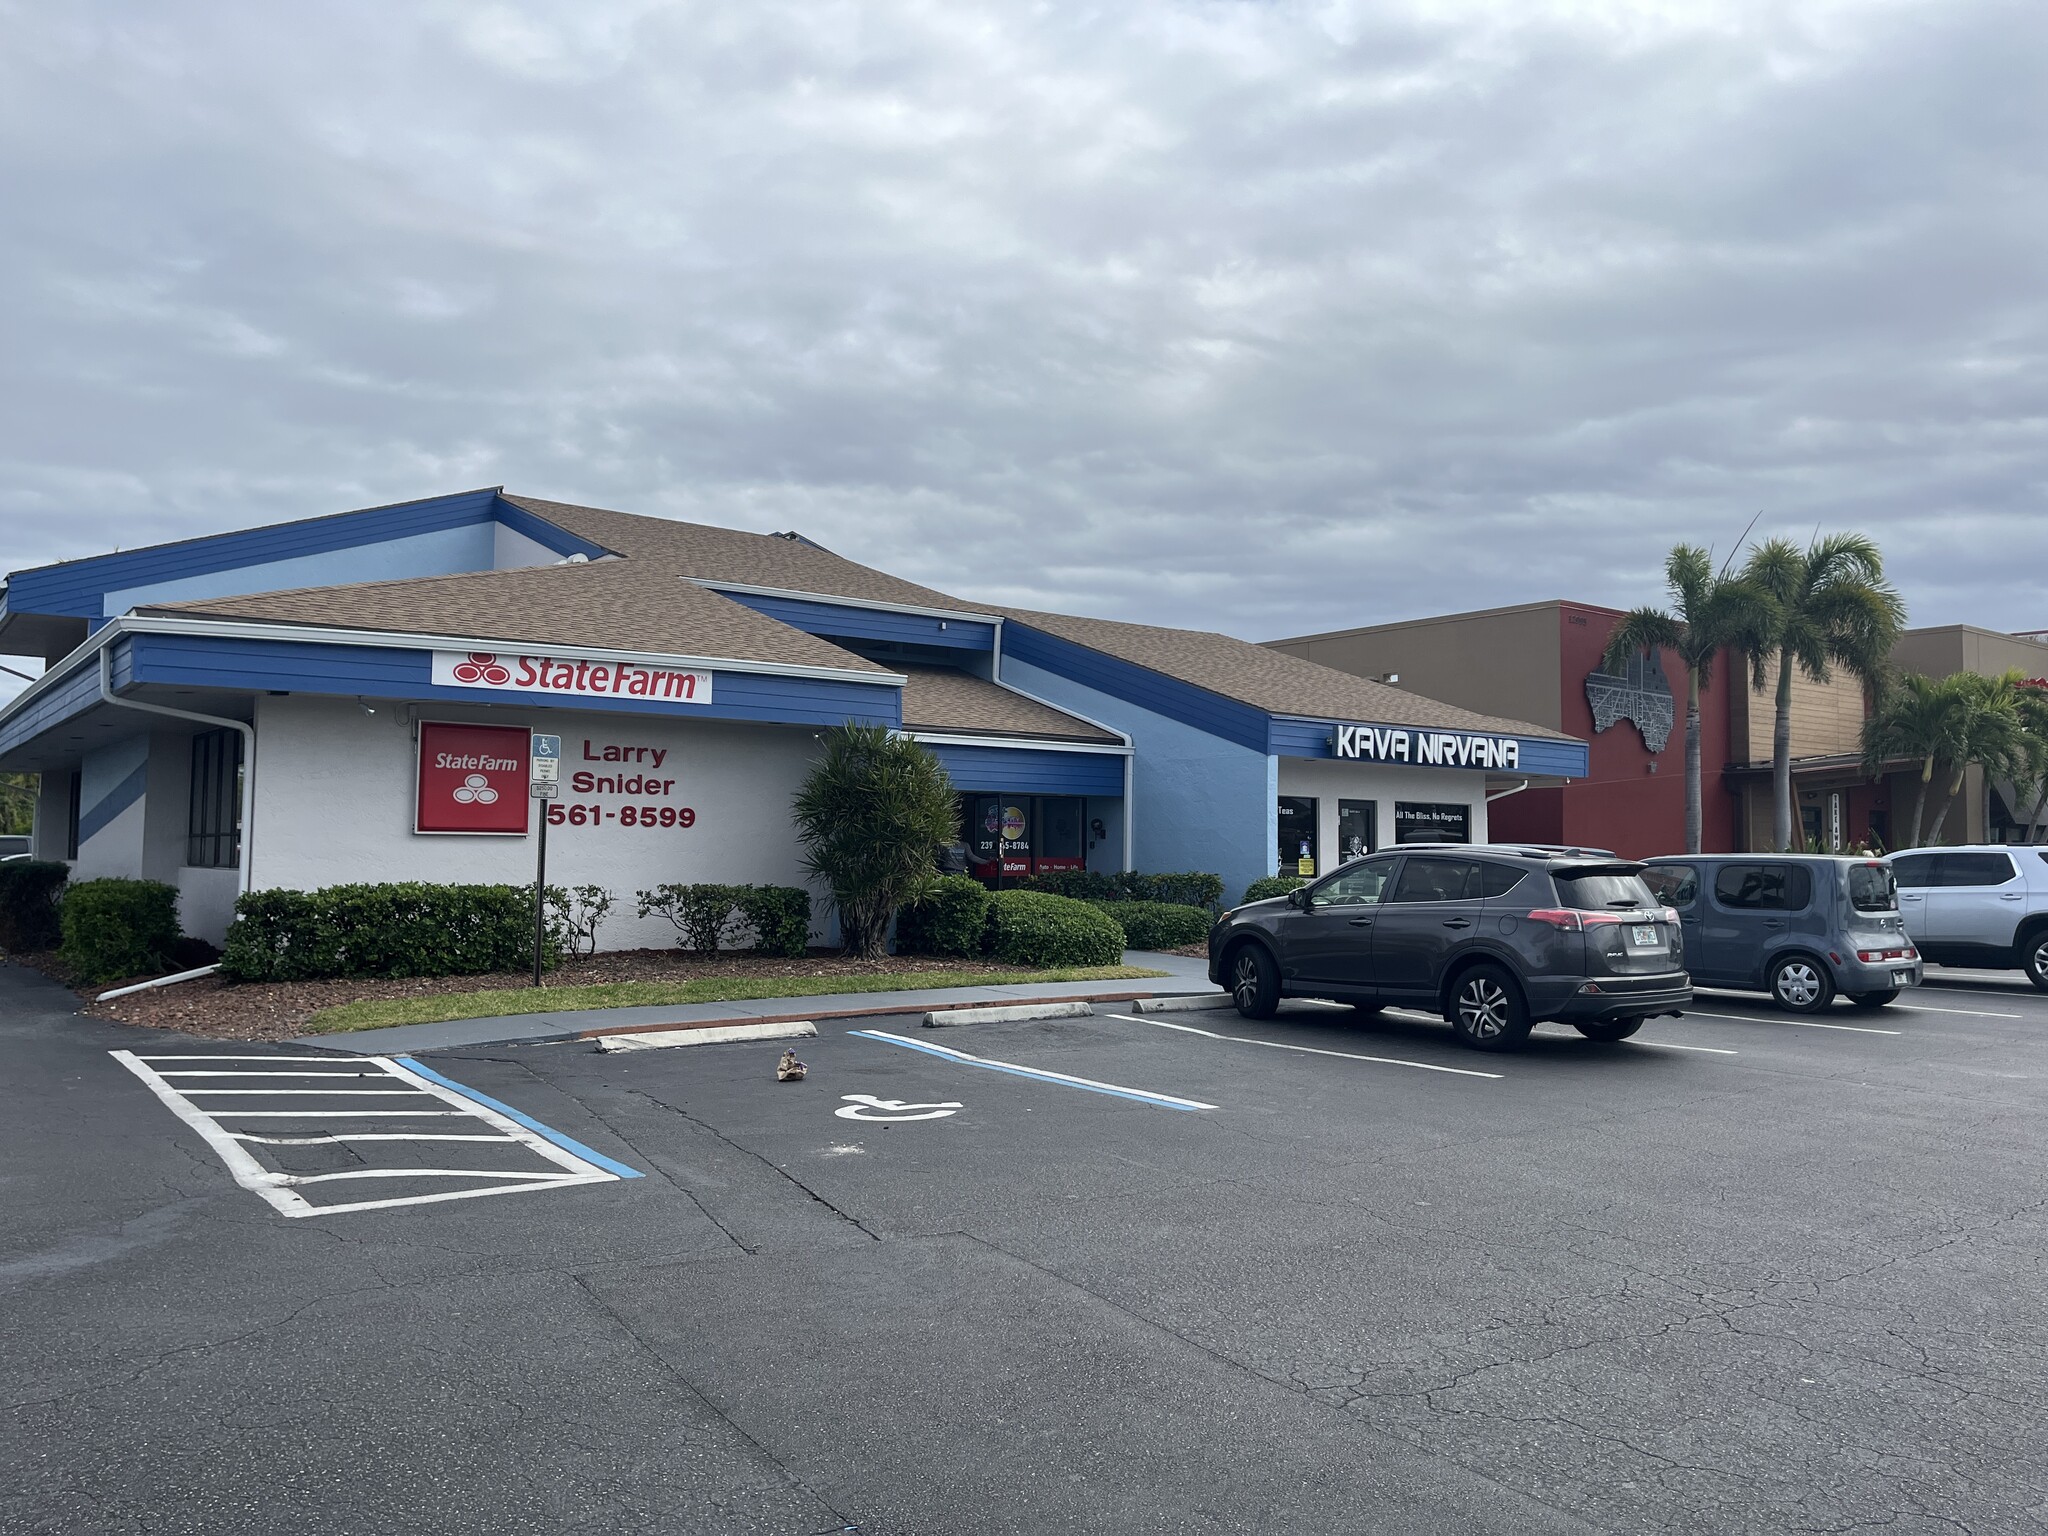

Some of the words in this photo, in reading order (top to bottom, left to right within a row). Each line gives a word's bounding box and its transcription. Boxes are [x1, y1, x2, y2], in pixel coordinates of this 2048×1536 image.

[583, 740, 667, 768] Larry
[1337, 725, 1410, 762] KAVA
[1417, 732, 1519, 769] NIRVANA
[572, 771, 675, 795] Snider
[547, 804, 696, 828] 561-8599
[1278, 806, 1294, 815] Teas
[1396, 811, 1404, 819] All
[1405, 811, 1415, 819] The
[1416, 812, 1431, 820] Bliss,
[1432, 812, 1440, 820] No
[1441, 812, 1463, 822] Regrets
[980, 841, 993, 850] 239
